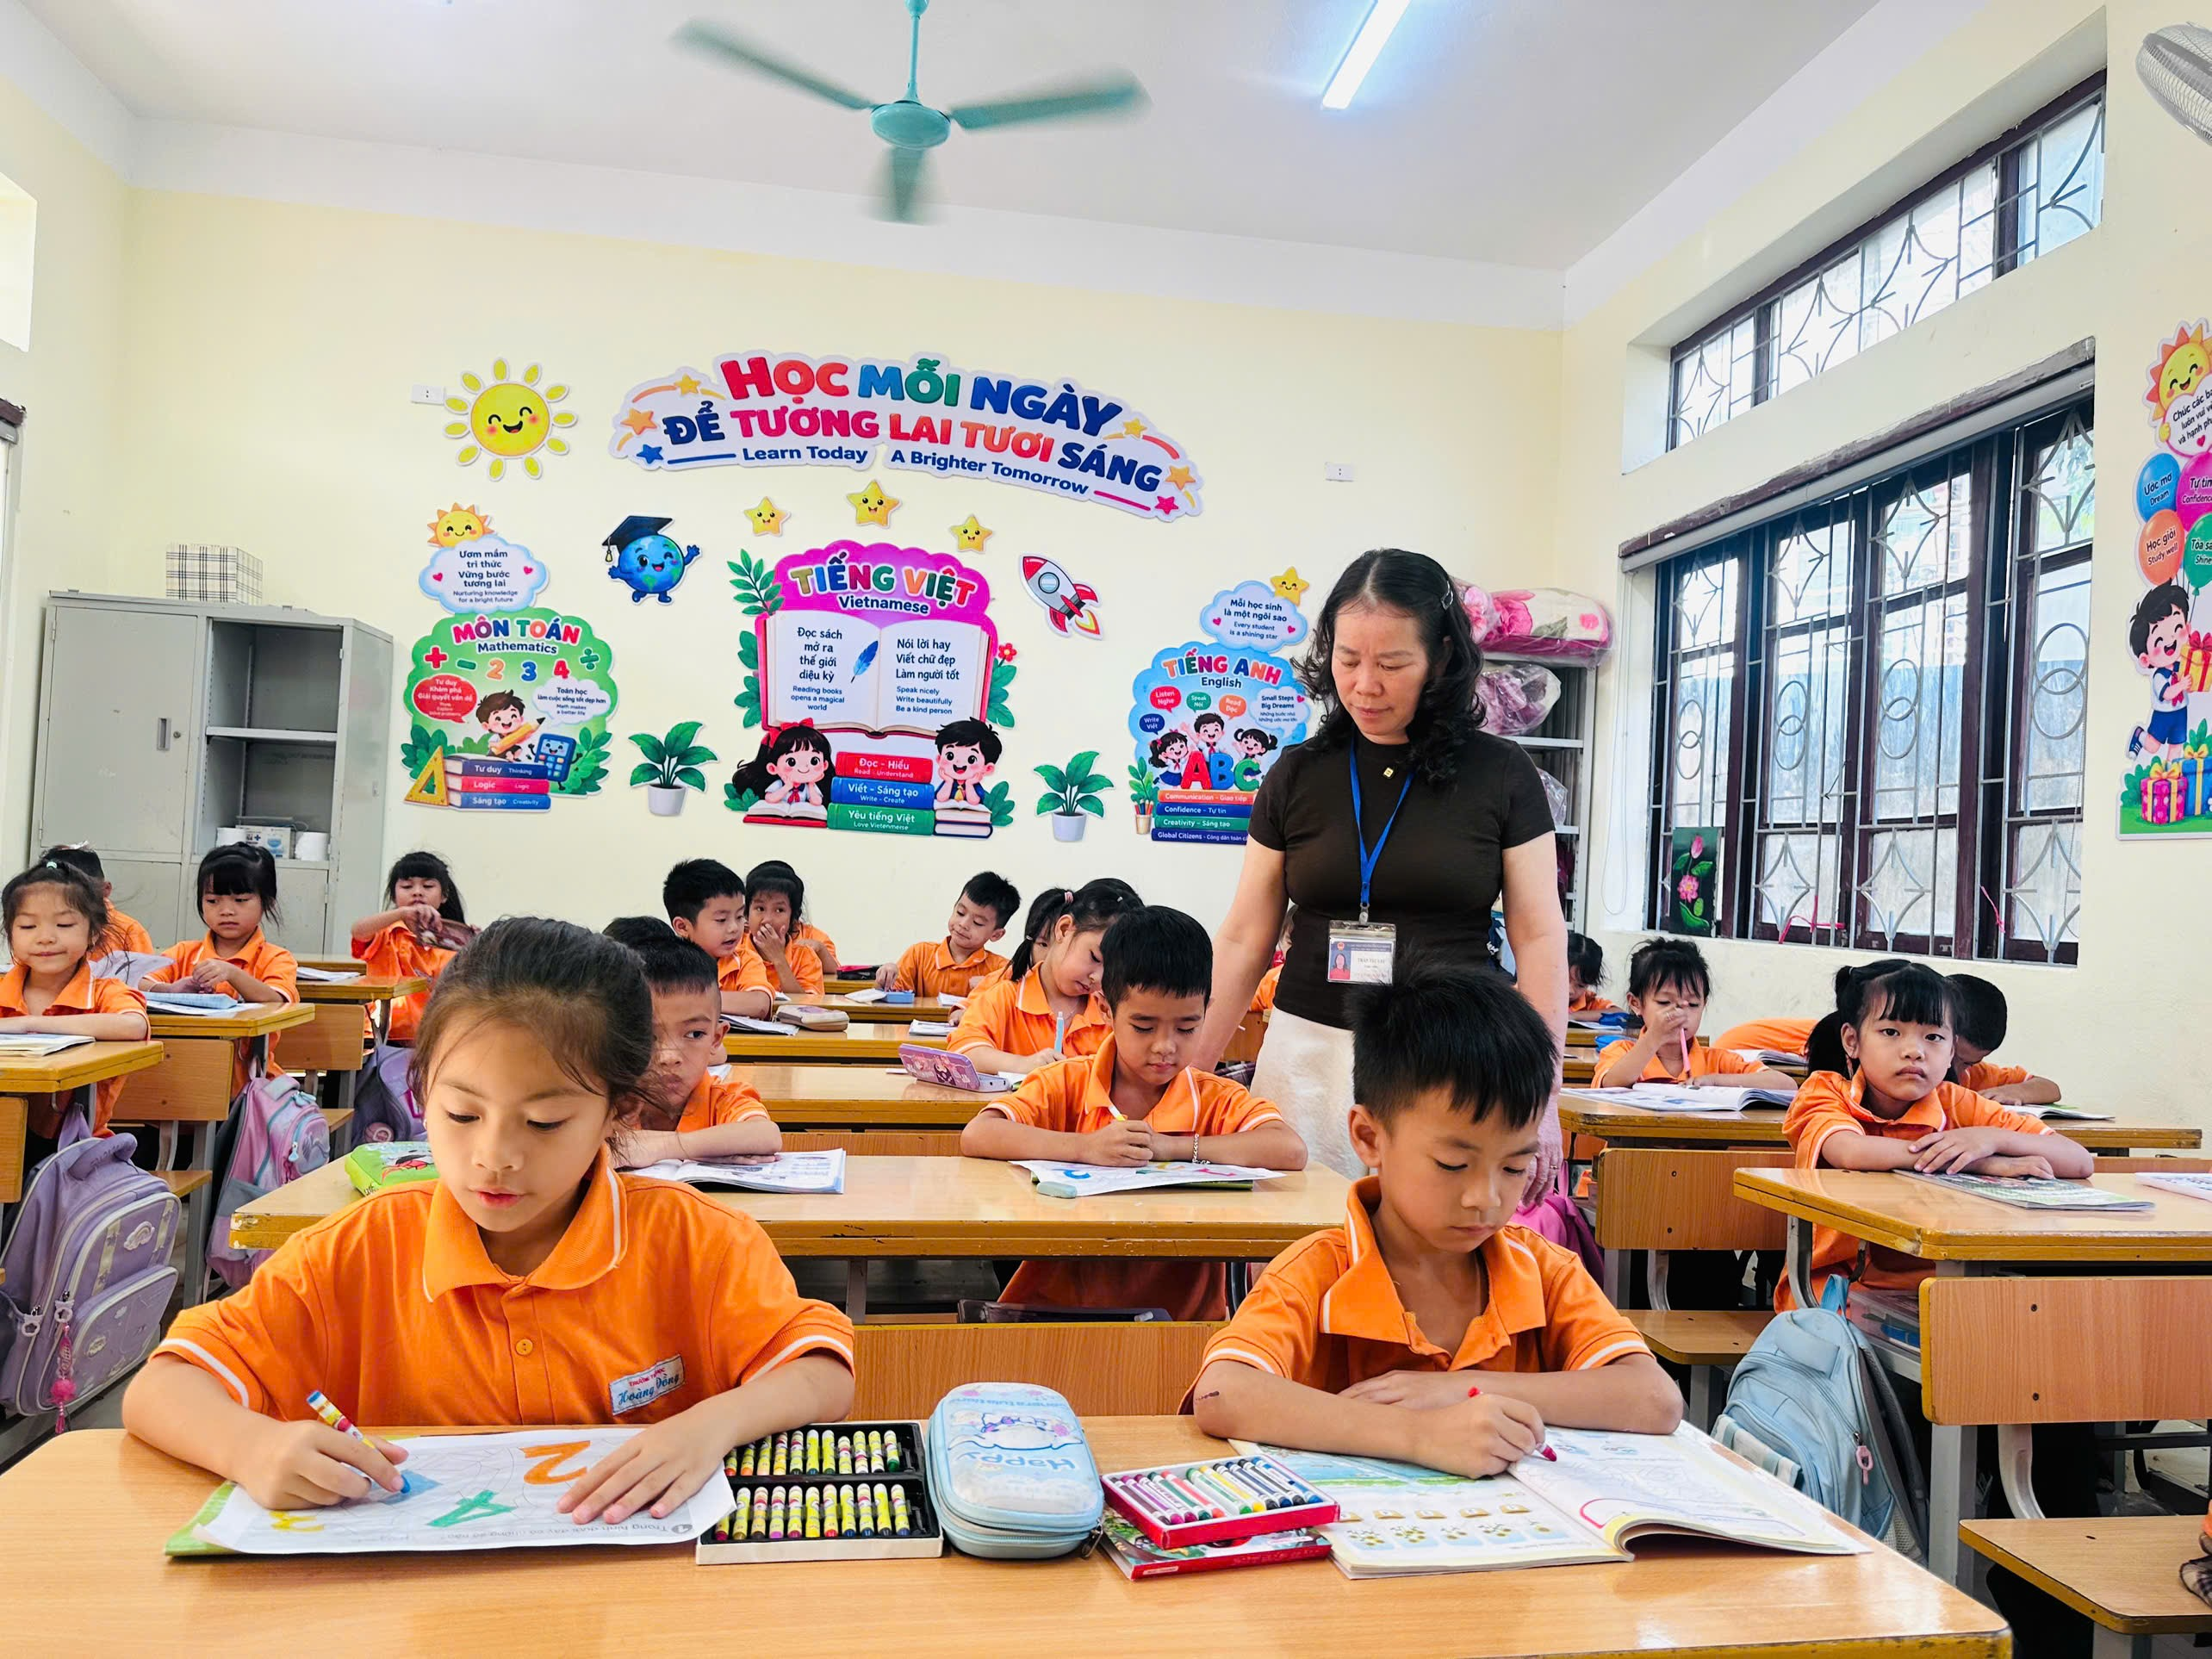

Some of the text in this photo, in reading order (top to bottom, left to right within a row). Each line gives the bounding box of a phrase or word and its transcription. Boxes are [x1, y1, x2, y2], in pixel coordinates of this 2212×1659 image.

[721, 357, 1122, 437] HỌC MỖI NGÀY
[2172, 395, 2204, 422] Chúc các
[2181, 407, 2205, 430] luôn vui
[2178, 424, 2203, 444] và hạnh
[662, 401, 1162, 492] ĐỂ TƯƠNG LAI TƯƠI SÁNG
[743, 445, 867, 463] Learn Today
[892, 450, 1089, 494] A Brighter Tomorrow
[2190, 478, 2201, 490] Tự
[2149, 490, 2169, 506] Dream
[2146, 538, 2160, 552] Học
[2147, 543, 2178, 565] Study well
[458, 571, 483, 580] Vững
[790, 551, 976, 608] TIẾNG VIỆT
[463, 580, 492, 588] tương
[838, 595, 929, 614] Vietnamese
[1230, 598, 1283, 612] Mỗi học sinh
[1233, 610, 1251, 619] một
[1252, 612, 1271, 621] ngôi
[452, 615, 581, 644] MÔN TOÁN
[797, 626, 842, 639] Đọc sách
[1233, 621, 1251, 630] Every
[1242, 631, 1264, 639] shining
[477, 642, 557, 654] Mathematics
[805, 641, 834, 653] mở ra
[897, 638, 951, 652] Nói lời hay
[799, 654, 837, 668] thế giới
[896, 652, 956, 668] Viết chữ đẹp
[1162, 648, 1283, 686] TIẾNG ANH
[487, 659, 570, 681] 2 3 4
[799, 669, 835, 683] diệu kỳ
[896, 668, 960, 681] Làm người tốt
[1201, 676, 1242, 689] English
[792, 686, 821, 694] Reading
[919, 687, 940, 696] nicely
[916, 697, 953, 706] beautifully
[487, 765, 502, 774] duy
[859, 758, 878, 767] Đọc
[877, 770, 914, 779] Understand
[1180, 750, 1260, 791] ABC
[473, 780, 496, 790] Logic
[848, 783, 919, 798] Viết Sáng tạo
[472, 796, 493, 806] Sáng
[1165, 792, 1214, 801] Communication
[848, 810, 916, 824] Yêu tiếng Việt
[1163, 818, 1196, 828] Creativity
[618, 1387, 655, 1405] Hoàng
[519, 1440, 591, 1485] 2
[426, 1489, 518, 1527] 4
